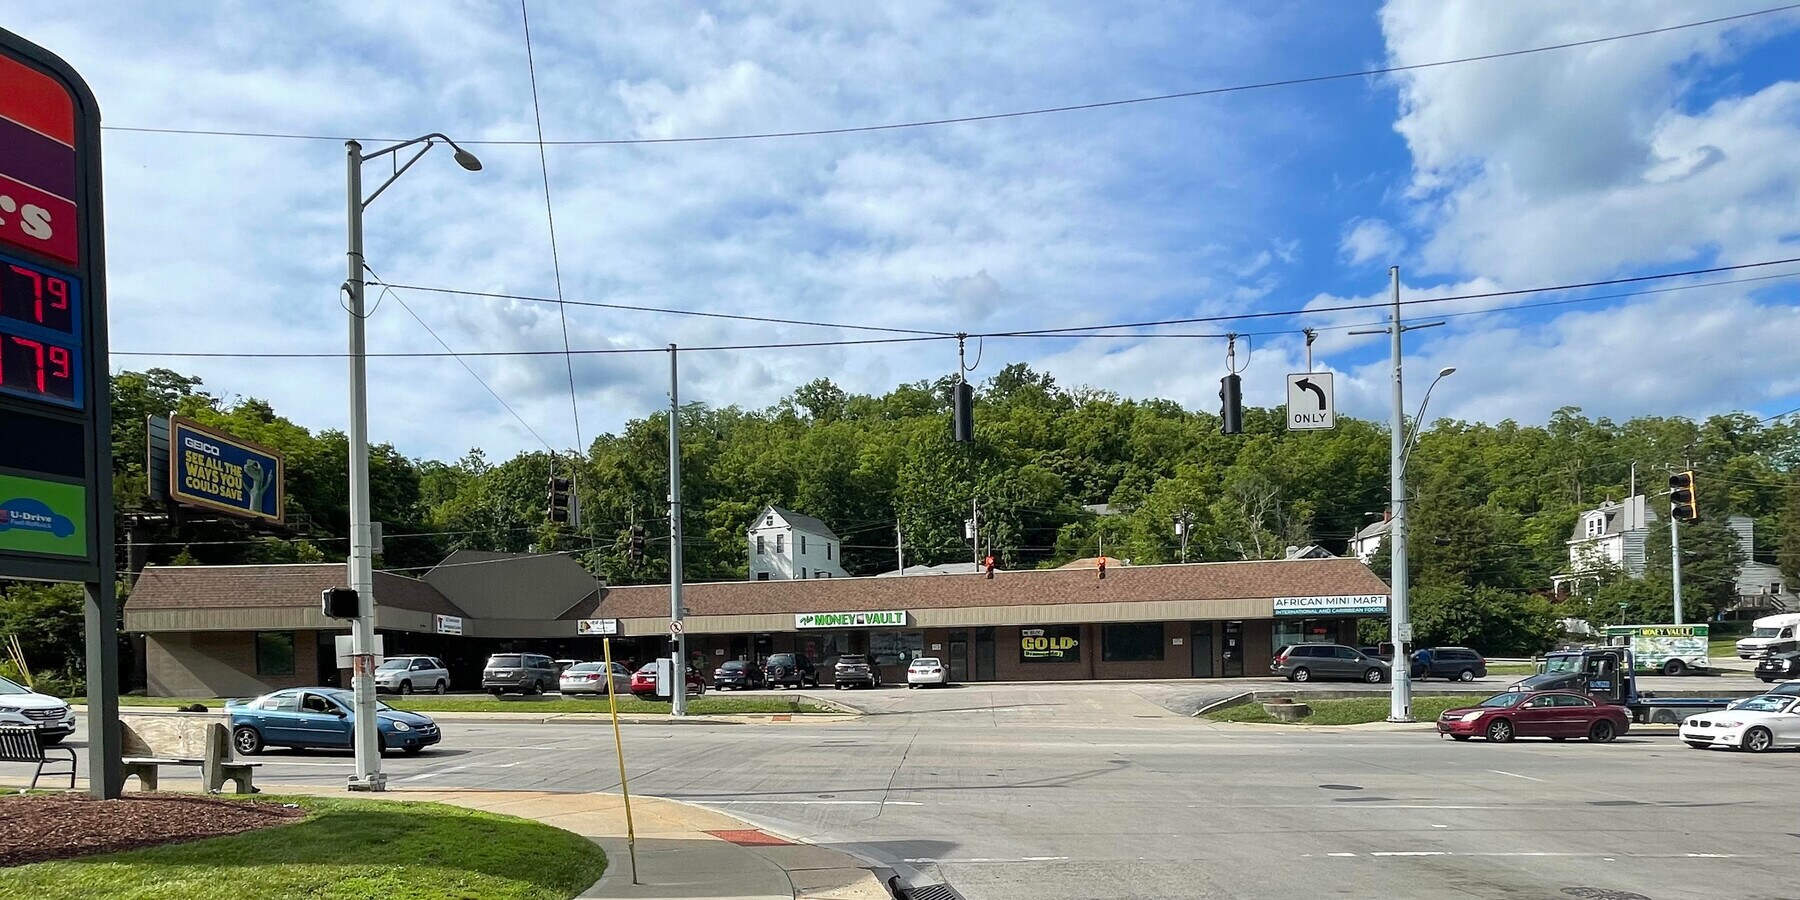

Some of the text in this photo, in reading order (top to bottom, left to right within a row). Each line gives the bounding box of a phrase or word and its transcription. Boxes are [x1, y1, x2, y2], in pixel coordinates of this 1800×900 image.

[1294, 413, 1327, 423] ONLY
[184, 437, 220, 456] GEICO
[185, 450, 242, 478] SEE ALL THE
[185, 461, 243, 490] WAYS YOU
[185, 476, 243, 502] COULD SAVE
[10, 510, 52, 523] U-Drive
[1275, 596, 1384, 607] AFRICAN MINI MART
[814, 613, 856, 626] MONEY
[865, 612, 903, 624] VAULT
[1642, 628, 1664, 636] MONEY
[1667, 628, 1690, 636] VAULT
[1021, 636, 1074, 650] GOLD
